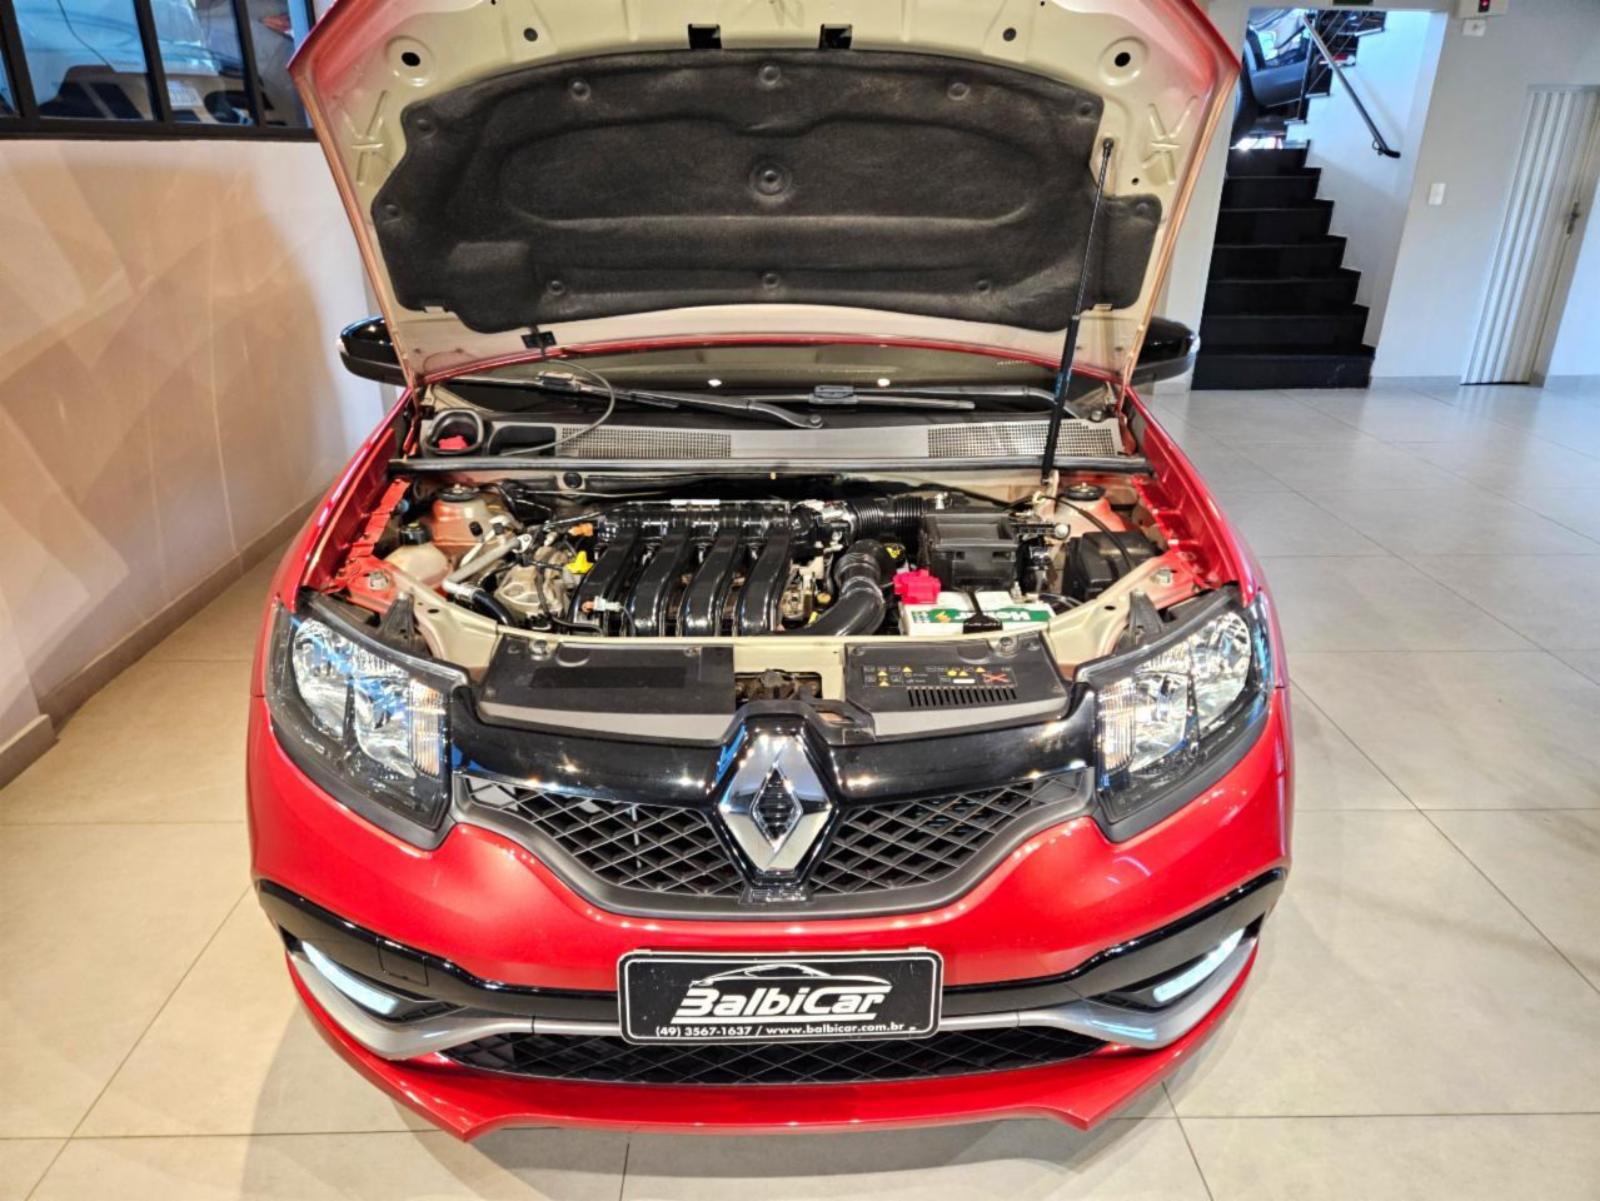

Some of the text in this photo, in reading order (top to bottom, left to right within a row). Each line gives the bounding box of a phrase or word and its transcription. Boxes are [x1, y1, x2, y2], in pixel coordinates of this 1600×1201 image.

[675, 985, 893, 1017] BalbiCar
[656, 1021, 905, 1037] (49) 3567-1637 / www.balbicar.com.br
